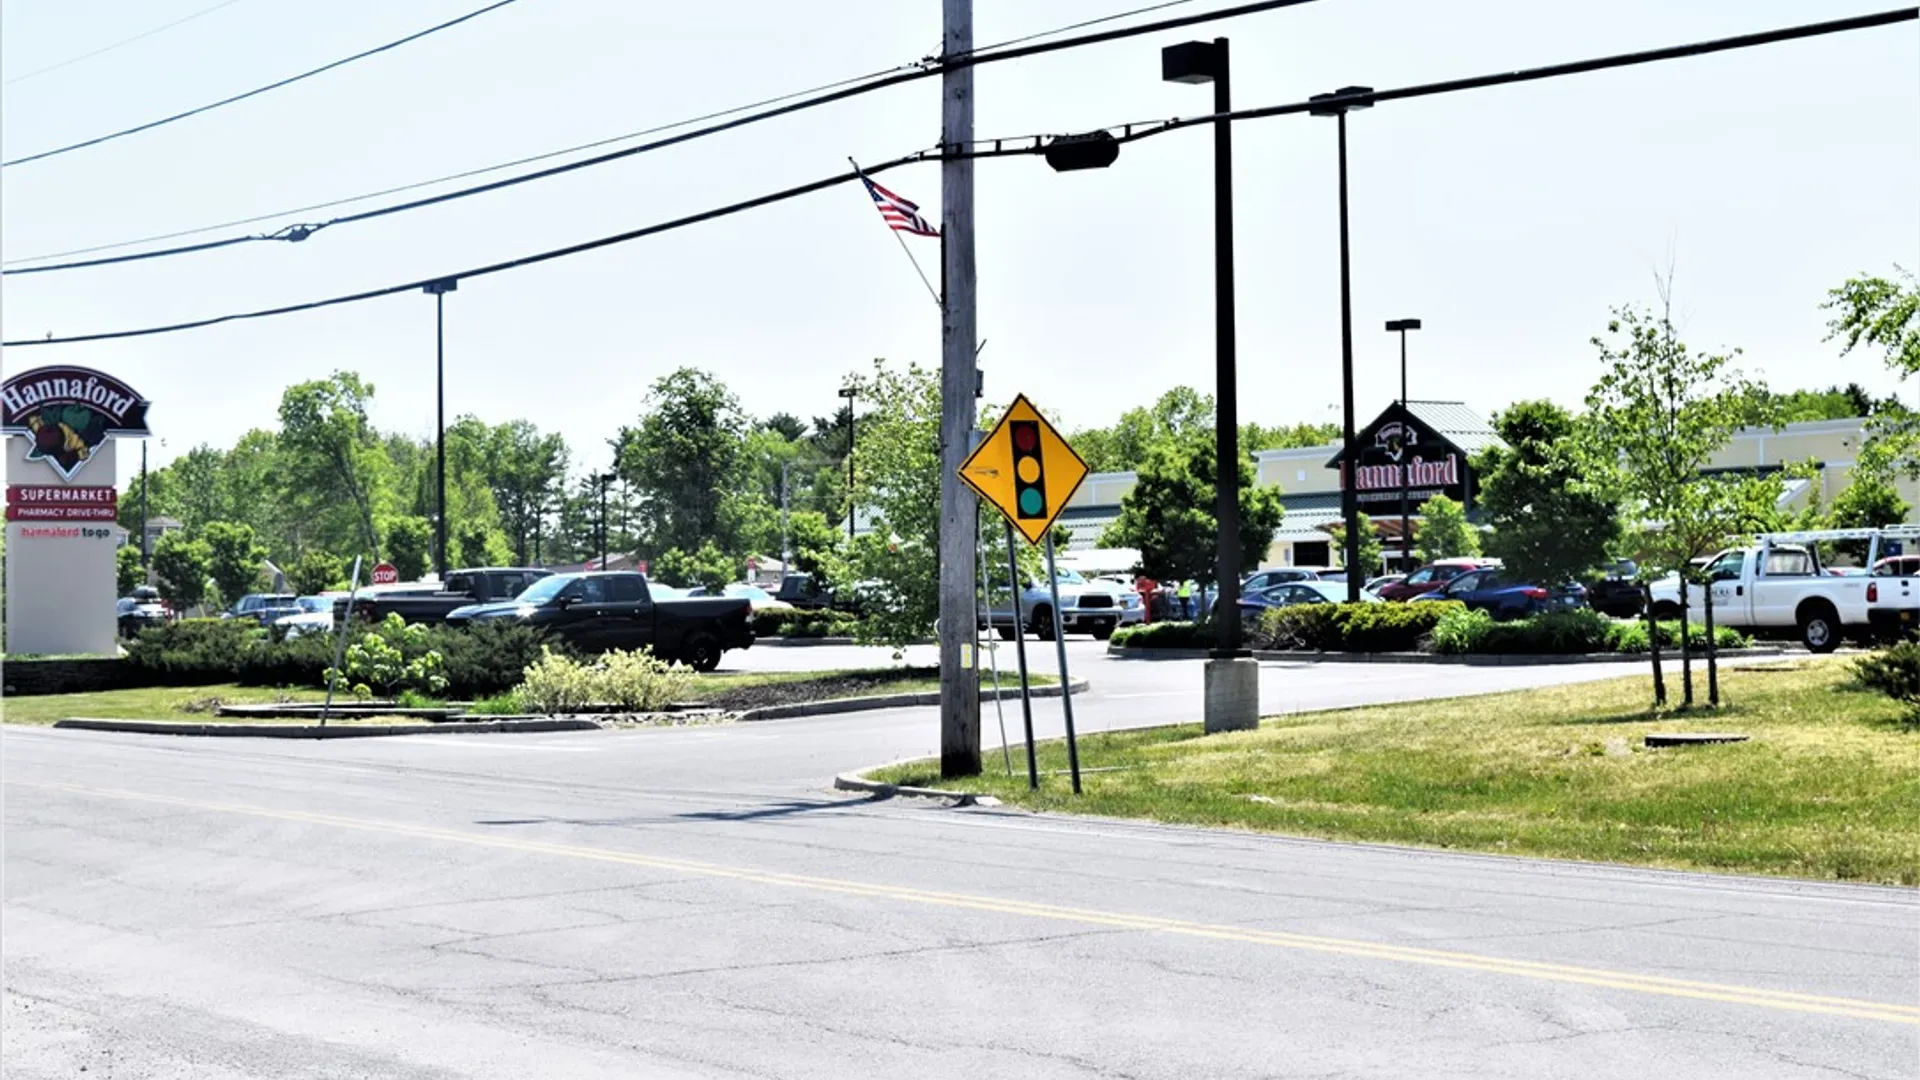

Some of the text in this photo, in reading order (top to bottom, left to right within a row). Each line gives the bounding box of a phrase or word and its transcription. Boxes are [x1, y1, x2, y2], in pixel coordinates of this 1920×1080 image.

[1, 376, 136, 418] Hannaford
[20, 488, 113, 501] SUPERMARKET
[17, 507, 115, 517] PHARMACY DRIVE-THRU
[21, 526, 81, 539] hannaford
[374, 570, 397, 582] STOP
